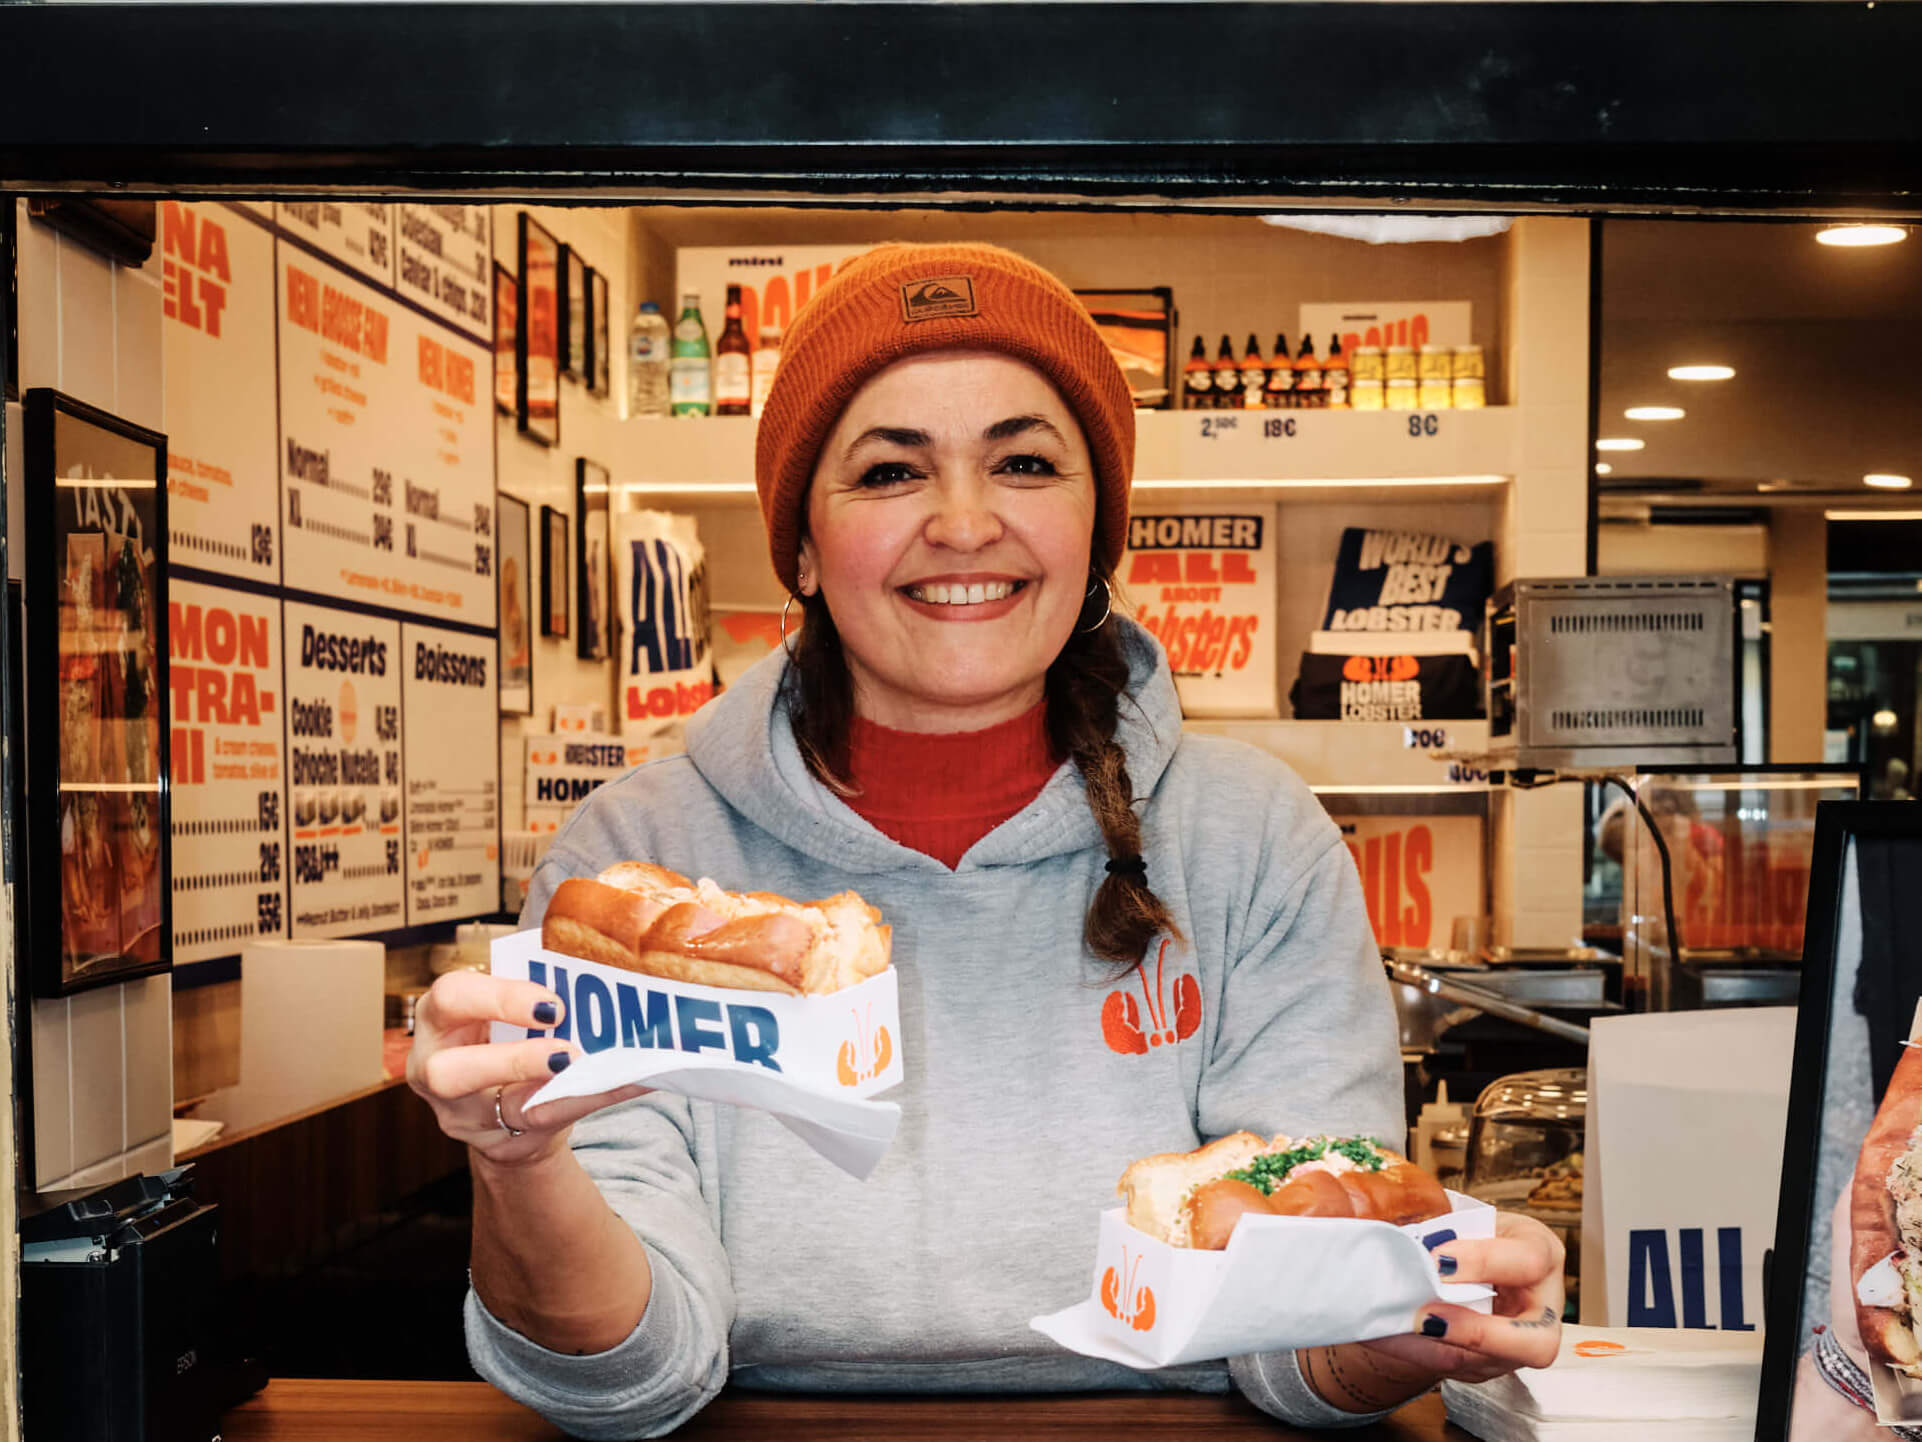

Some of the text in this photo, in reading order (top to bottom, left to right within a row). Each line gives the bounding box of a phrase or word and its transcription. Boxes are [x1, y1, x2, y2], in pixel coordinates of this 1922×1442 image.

[1131, 518, 1256, 547] HOMER
[1358, 531, 1472, 570] WORLDS
[1127, 553, 1256, 584] ALL
[1378, 564, 1452, 606] BEST
[1160, 587, 1222, 603] ABOUT
[168, 601, 269, 669] MON
[1136, 604, 1259, 672] bsters
[1330, 606, 1462, 631] LOBSTER
[301, 624, 387, 677] Desserts
[415, 641, 487, 688] Boissons
[169, 664, 275, 726] TRA-
[1341, 681, 1421, 704] HOMER
[292, 697, 332, 738] Cookie
[292, 746, 338, 786] Brioche
[1346, 824, 1433, 949] LLS
[1627, 1227, 1756, 1332] ALL
